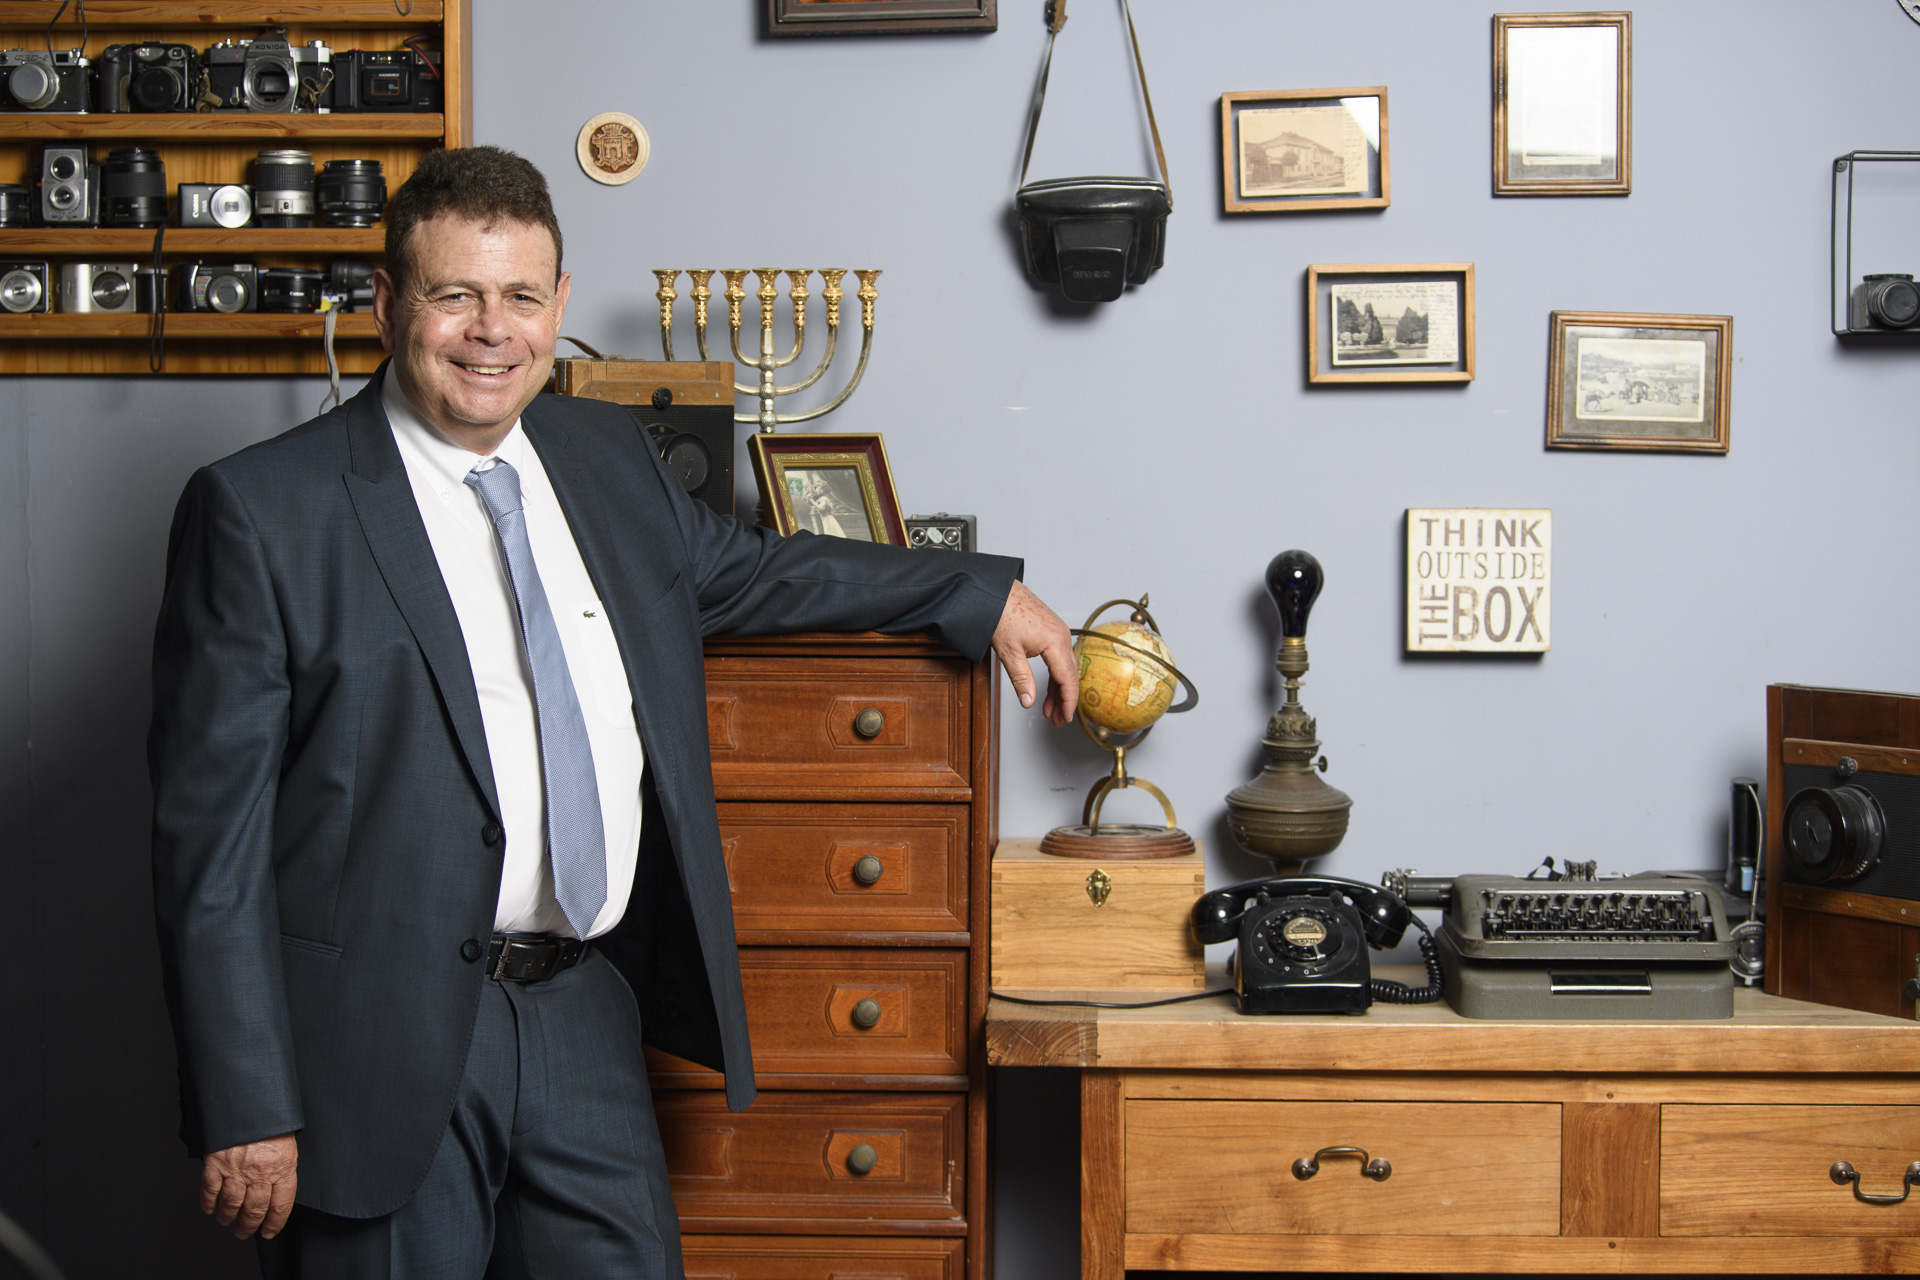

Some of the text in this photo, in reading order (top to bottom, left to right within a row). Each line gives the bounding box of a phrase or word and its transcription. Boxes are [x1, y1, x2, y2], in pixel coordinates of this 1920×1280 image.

[1419, 518, 1543, 548] THINK
[1417, 551, 1545, 580] OUTSIDE
[1418, 583, 1544, 645] THE BOX
